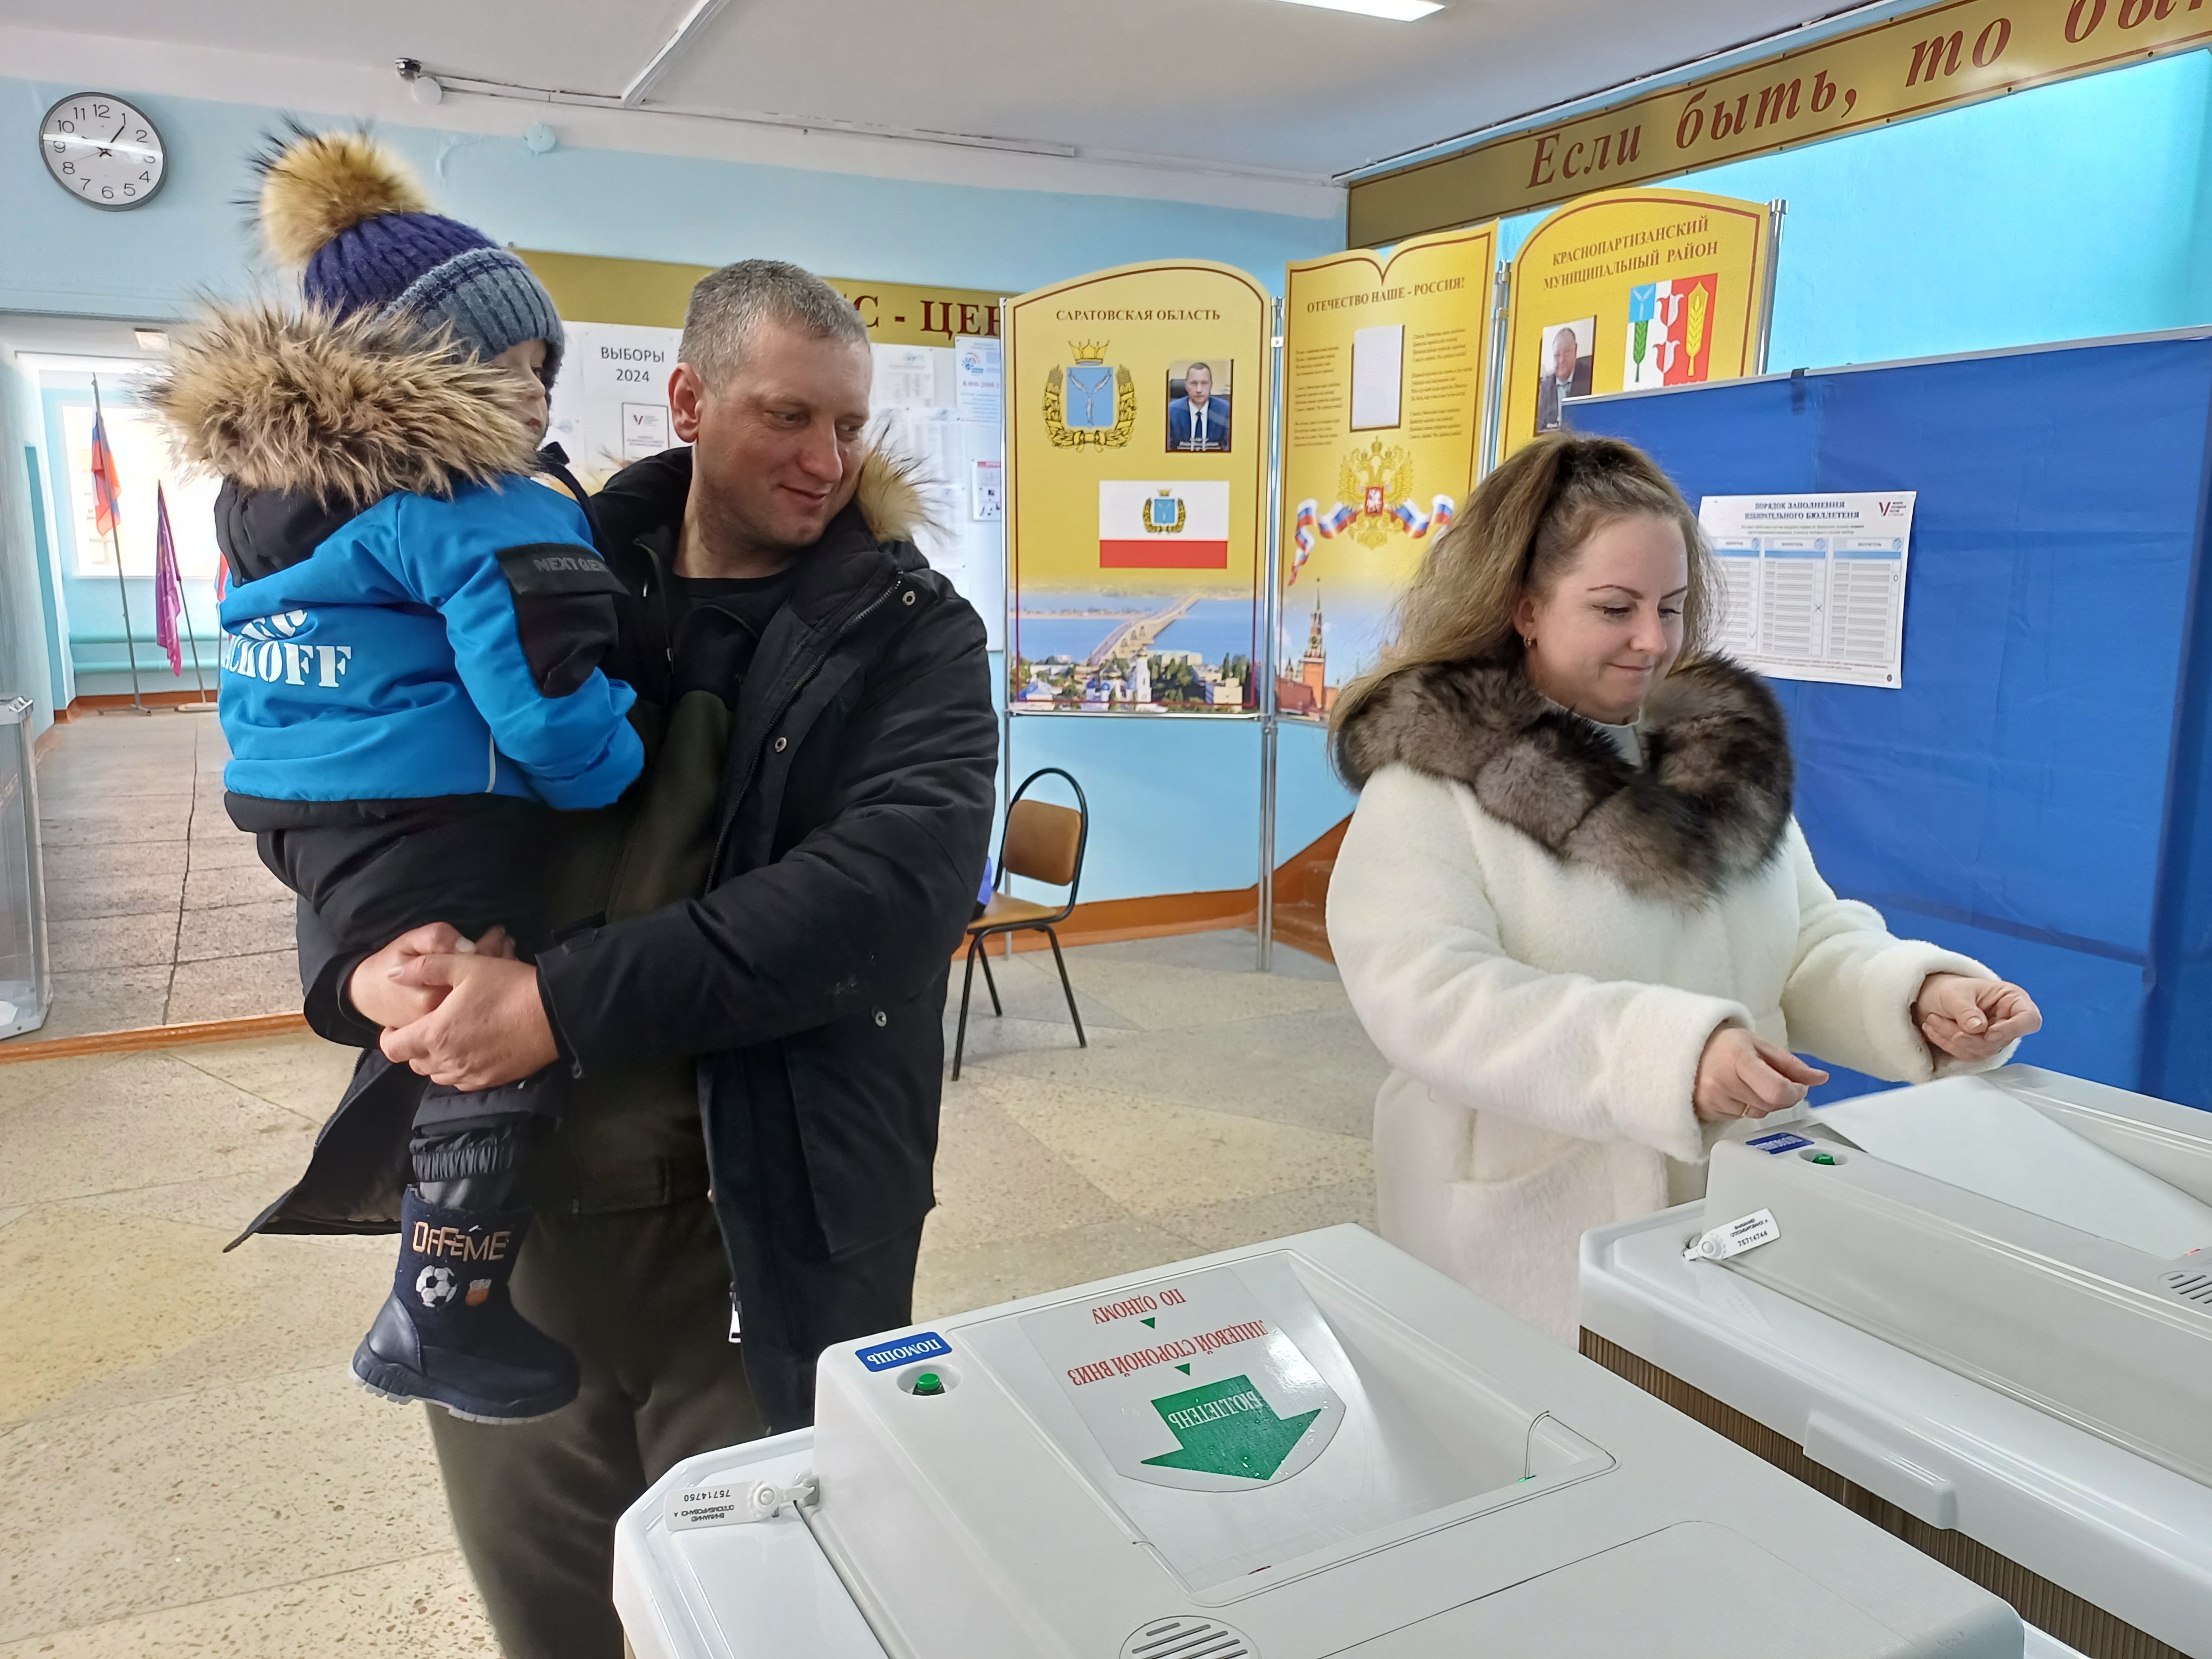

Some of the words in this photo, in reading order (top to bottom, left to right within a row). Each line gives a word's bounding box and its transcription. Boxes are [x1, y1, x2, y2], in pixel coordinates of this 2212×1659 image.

[1526, 126, 1641, 189] Если
[1676, 70, 1857, 149] быть,
[1906, 18, 2011, 87] то
[2065, 0, 2205, 44] бы
[74, 107, 85, 120] 11
[93, 104, 110, 118] 12
[58, 120, 74, 133] 10
[136, 130, 148, 143] 2
[53, 141, 65, 153] 9
[62, 162, 75, 174] 8
[80, 178, 91, 190] 7
[139, 171, 150, 183] 4
[102, 186, 114, 199] 6
[124, 183, 136, 196] 5
[1553, 215, 1708, 266] КРАСНОПАРТИЗАНСКИЙ
[1543, 249, 1659, 290] МУНИЦИПАЛЬНЫЙ
[1667, 241, 1718, 263] РАЙОН
[1307, 293, 1369, 313] ОТЕЧЕСТВО
[1371, 287, 1405, 302] НАШЕ
[1414, 277, 1465, 296] РОССИЯ!
[1056, 310, 1152, 321] САРАТОВСКАЯ
[1157, 310, 1221, 321] ОБЛАСТЬ
[601, 347, 664, 363] ВЫБОРЫ
[616, 368, 650, 383] 2024
[533, 557, 578, 571] NEXT
[1159, 1288, 1187, 1306] ПО
[1092, 1295, 1157, 1324] ОДНОМУ
[1192, 1320, 1269, 1355] ЛИЦЕВОЙ
[867, 1339, 942, 1364] ПОМОЩЬ
[1111, 1339, 1197, 1377] СТОРОНОЙ
[1067, 1360, 1115, 1386] ВНИЗ
[1167, 1391, 1264, 1430] БЮЛЛЕТЕНЬ
[684, 1489, 731, 1502] 75714750
